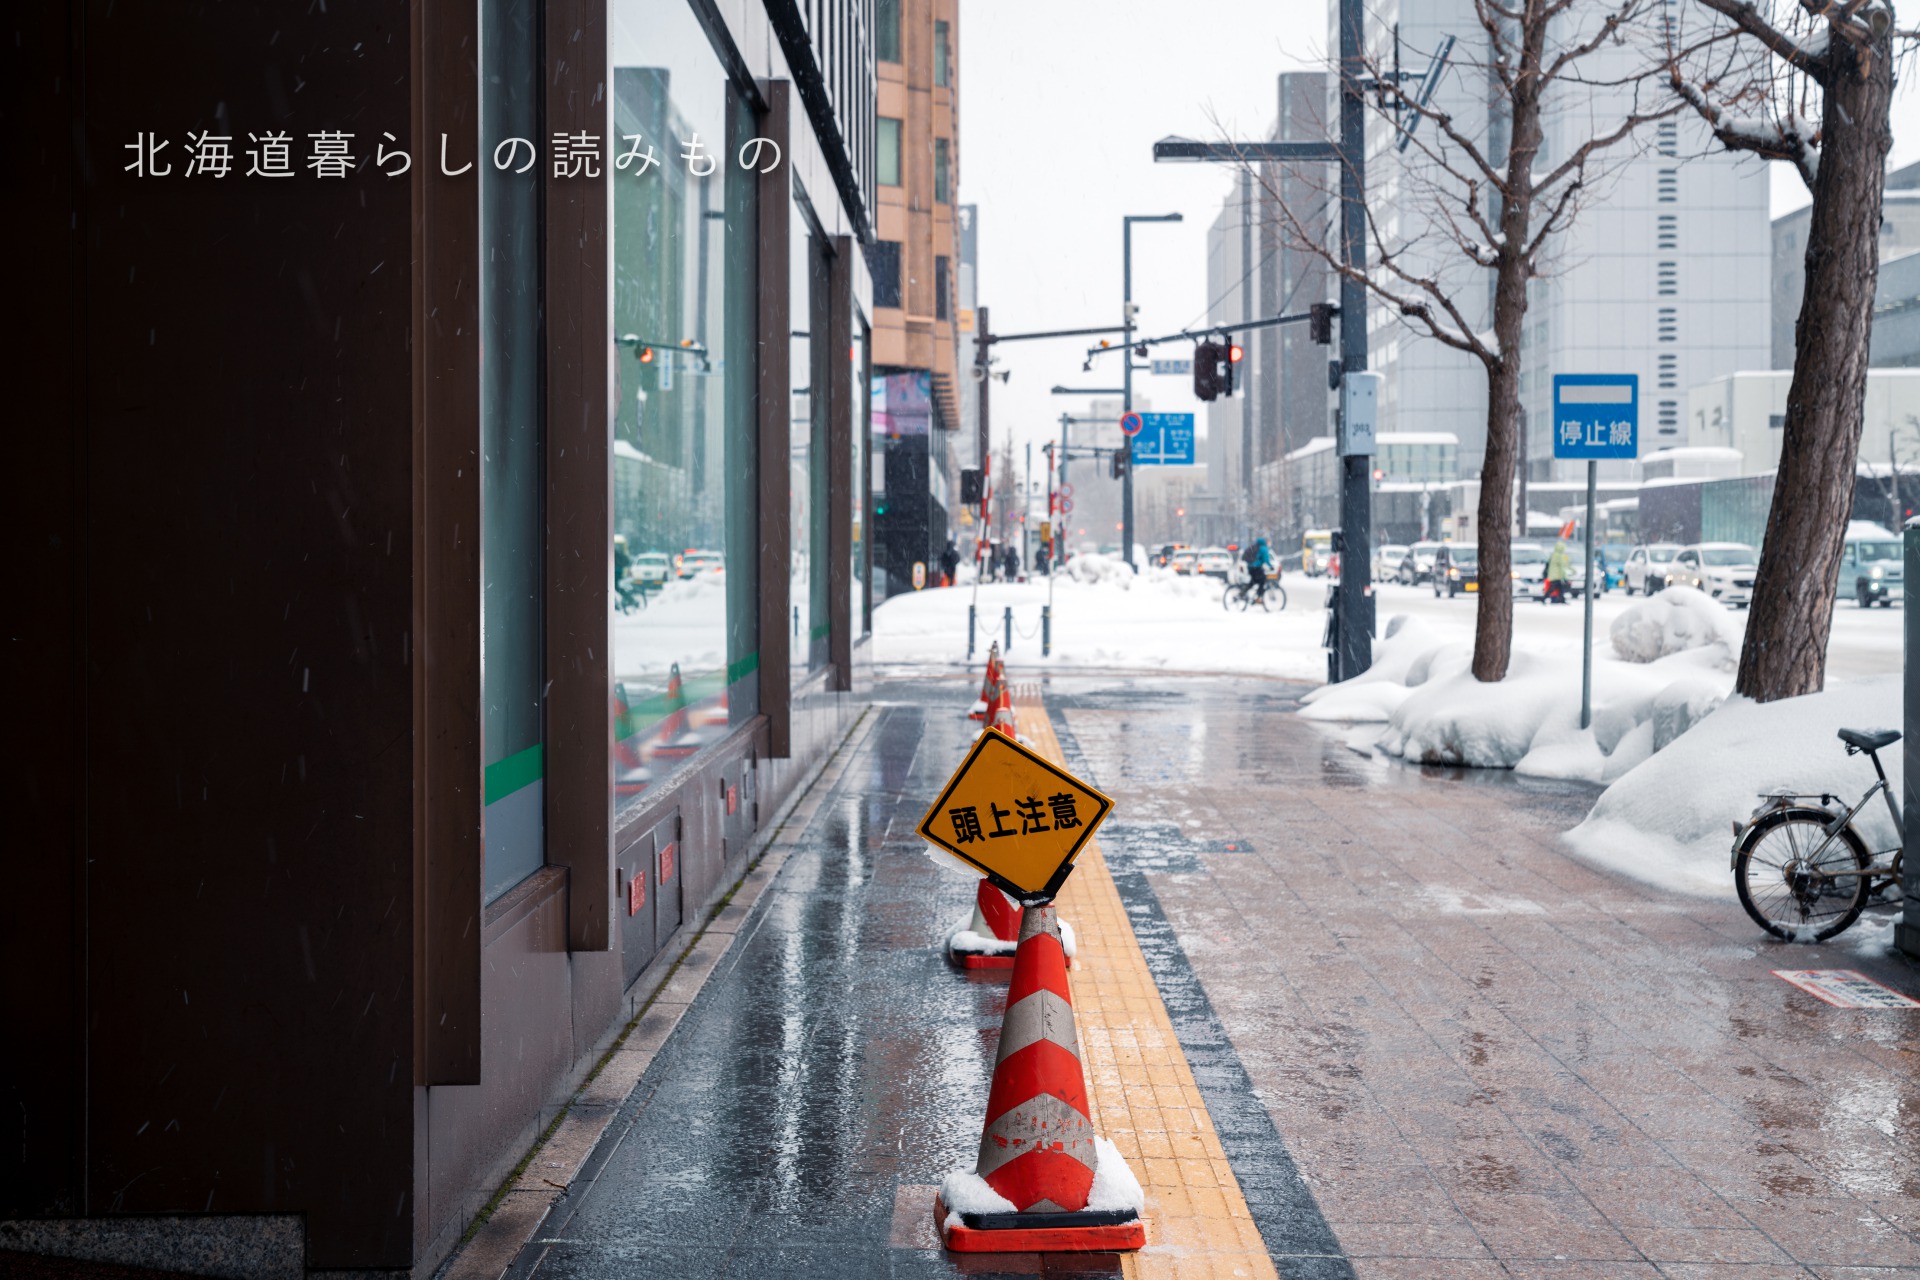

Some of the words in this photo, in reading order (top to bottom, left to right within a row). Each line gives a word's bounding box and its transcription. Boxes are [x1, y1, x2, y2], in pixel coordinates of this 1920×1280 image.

[1560, 419, 1632, 446] 停止線
[948, 792, 1083, 844] 頭上注意
